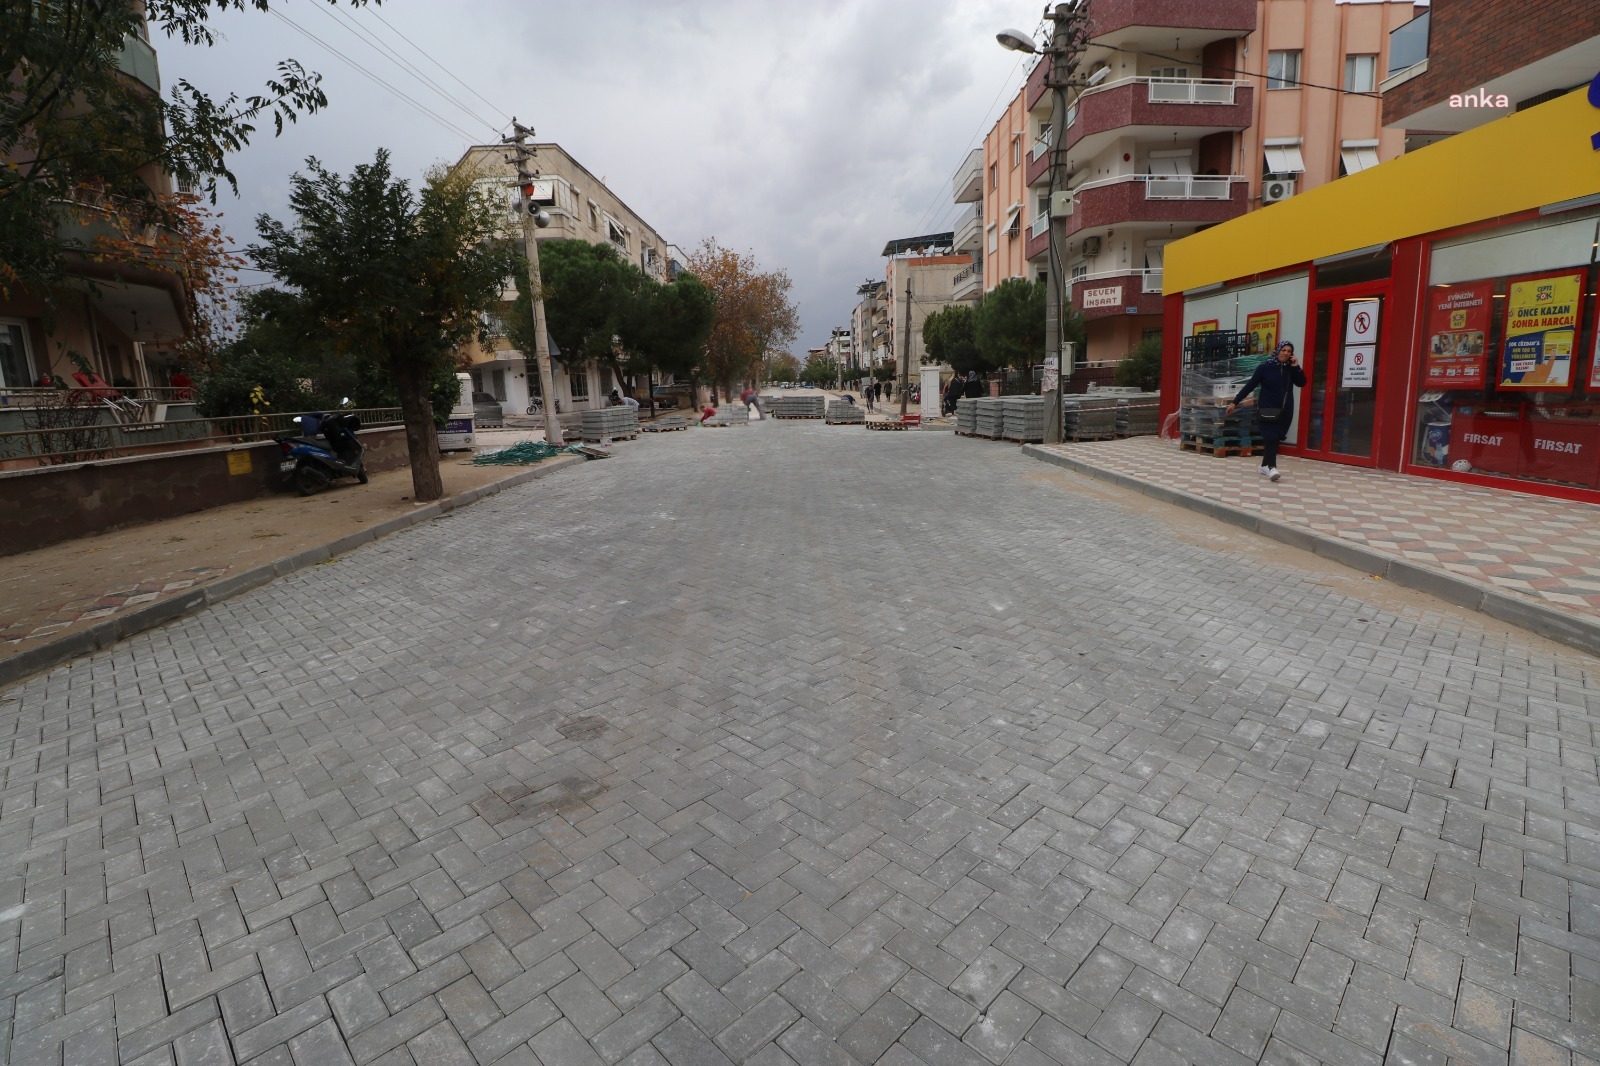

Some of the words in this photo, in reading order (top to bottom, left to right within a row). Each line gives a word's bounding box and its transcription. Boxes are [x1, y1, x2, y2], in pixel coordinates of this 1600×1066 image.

[1088, 288, 1116, 297] SEVEN
[1438, 302, 1452, 311] YENİ
[1453, 297, 1483, 309] İNTERNETİ
[1517, 307, 1538, 317] ÖNCE
[1540, 305, 1570, 316] KAZAN
[1512, 319, 1539, 329] SONRA
[1541, 315, 1574, 326] HARCA!
[1463, 433, 1503, 446] FIRSAT
[1534, 438, 1582, 454] FIRSAT
